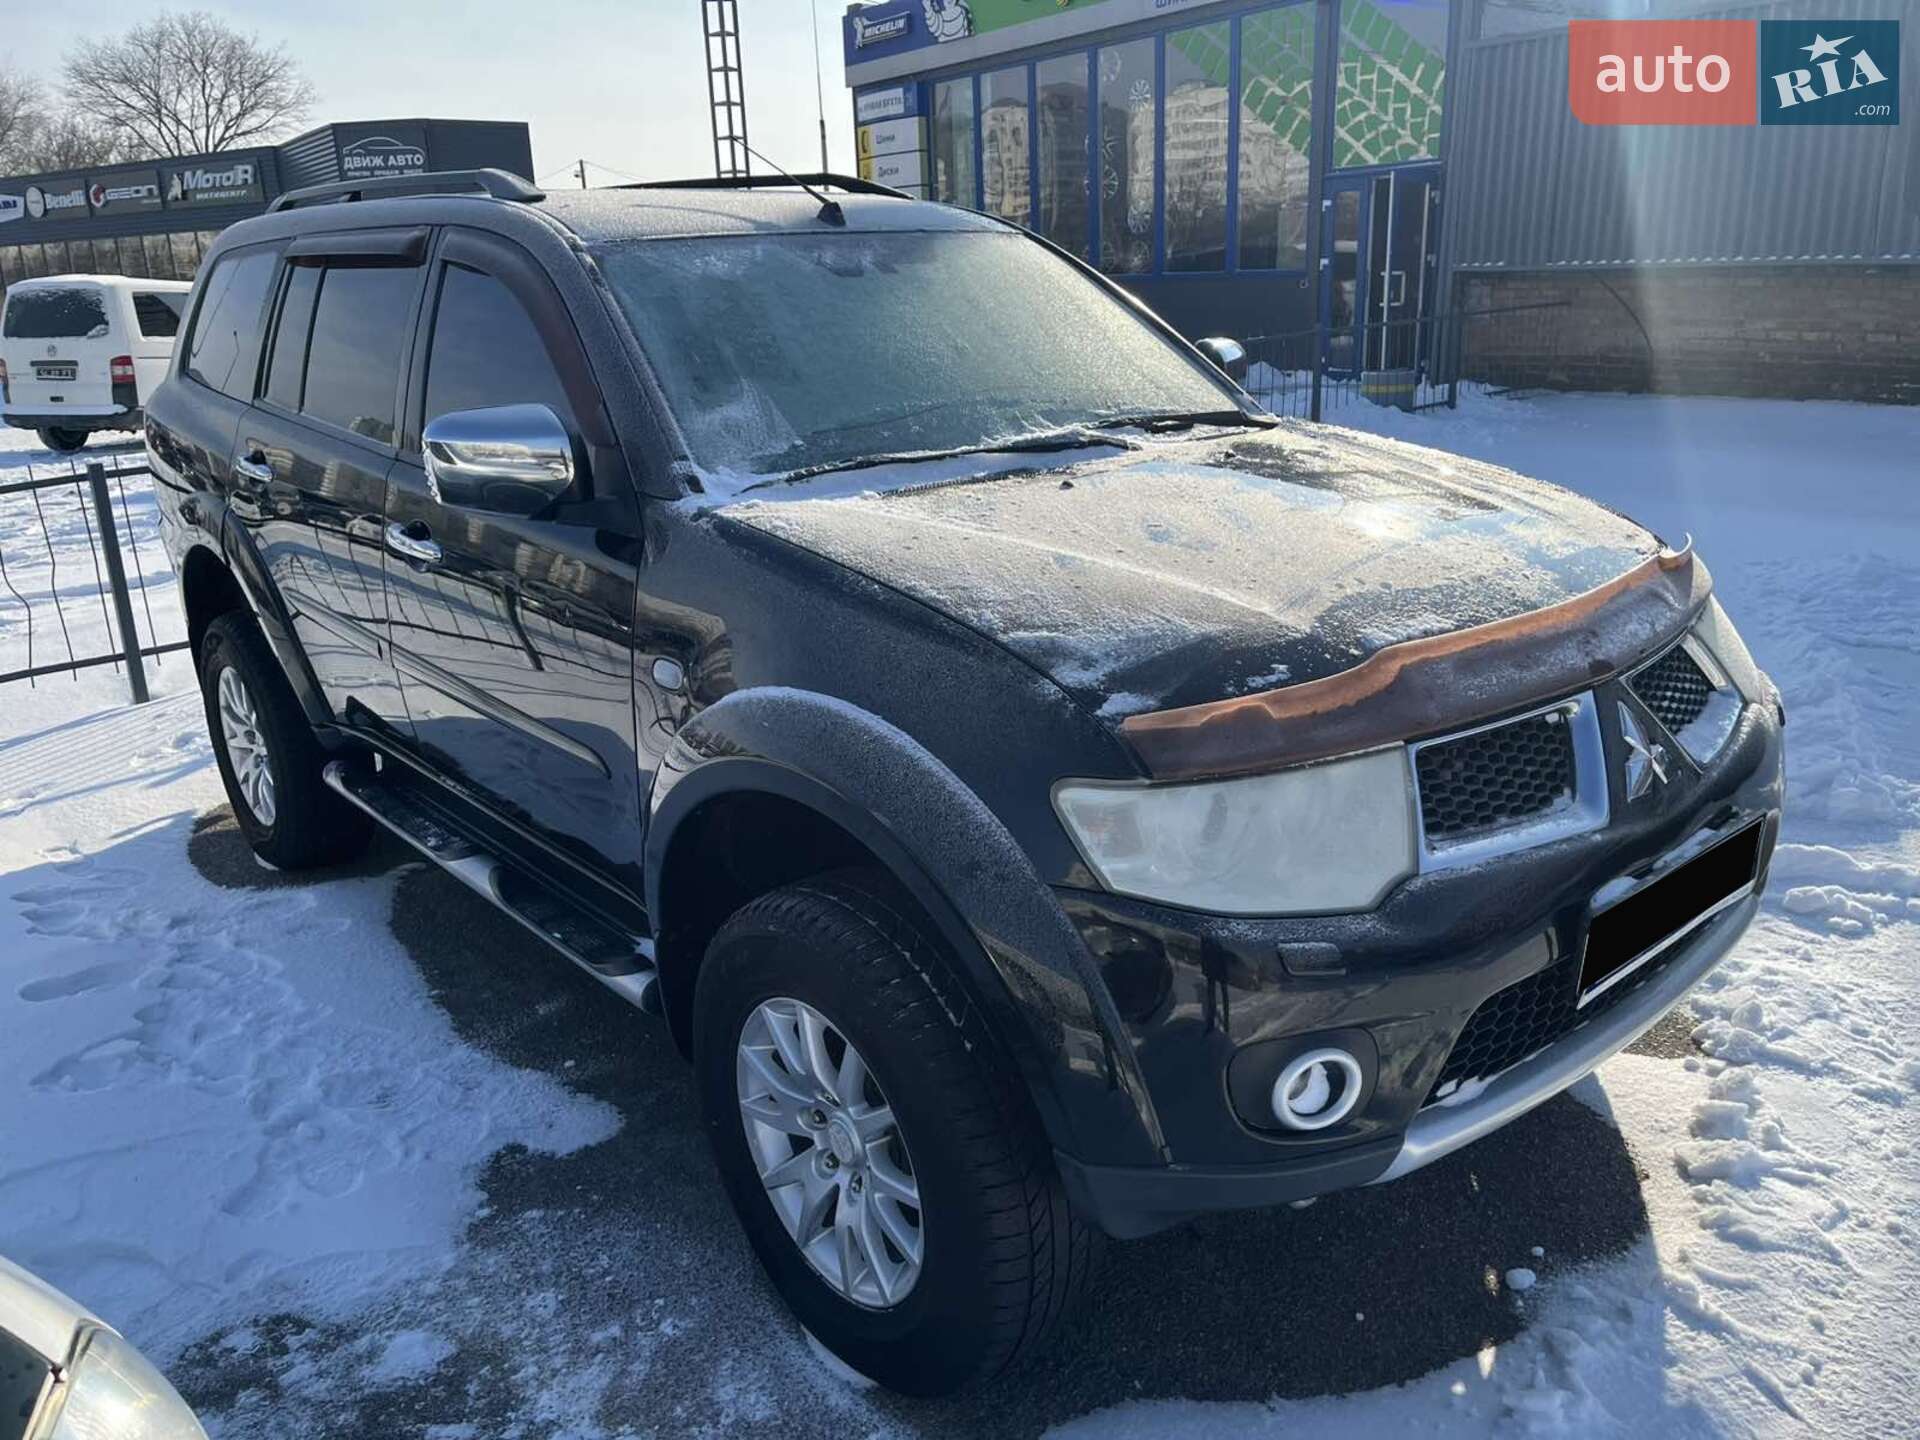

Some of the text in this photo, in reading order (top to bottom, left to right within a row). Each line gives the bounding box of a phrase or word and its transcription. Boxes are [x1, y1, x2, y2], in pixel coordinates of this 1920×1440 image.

[864, 18, 905, 37] MICHELIN
[343, 153, 424, 170] ДВИЖ АВТО
[44, 190, 86, 209] Benelli
